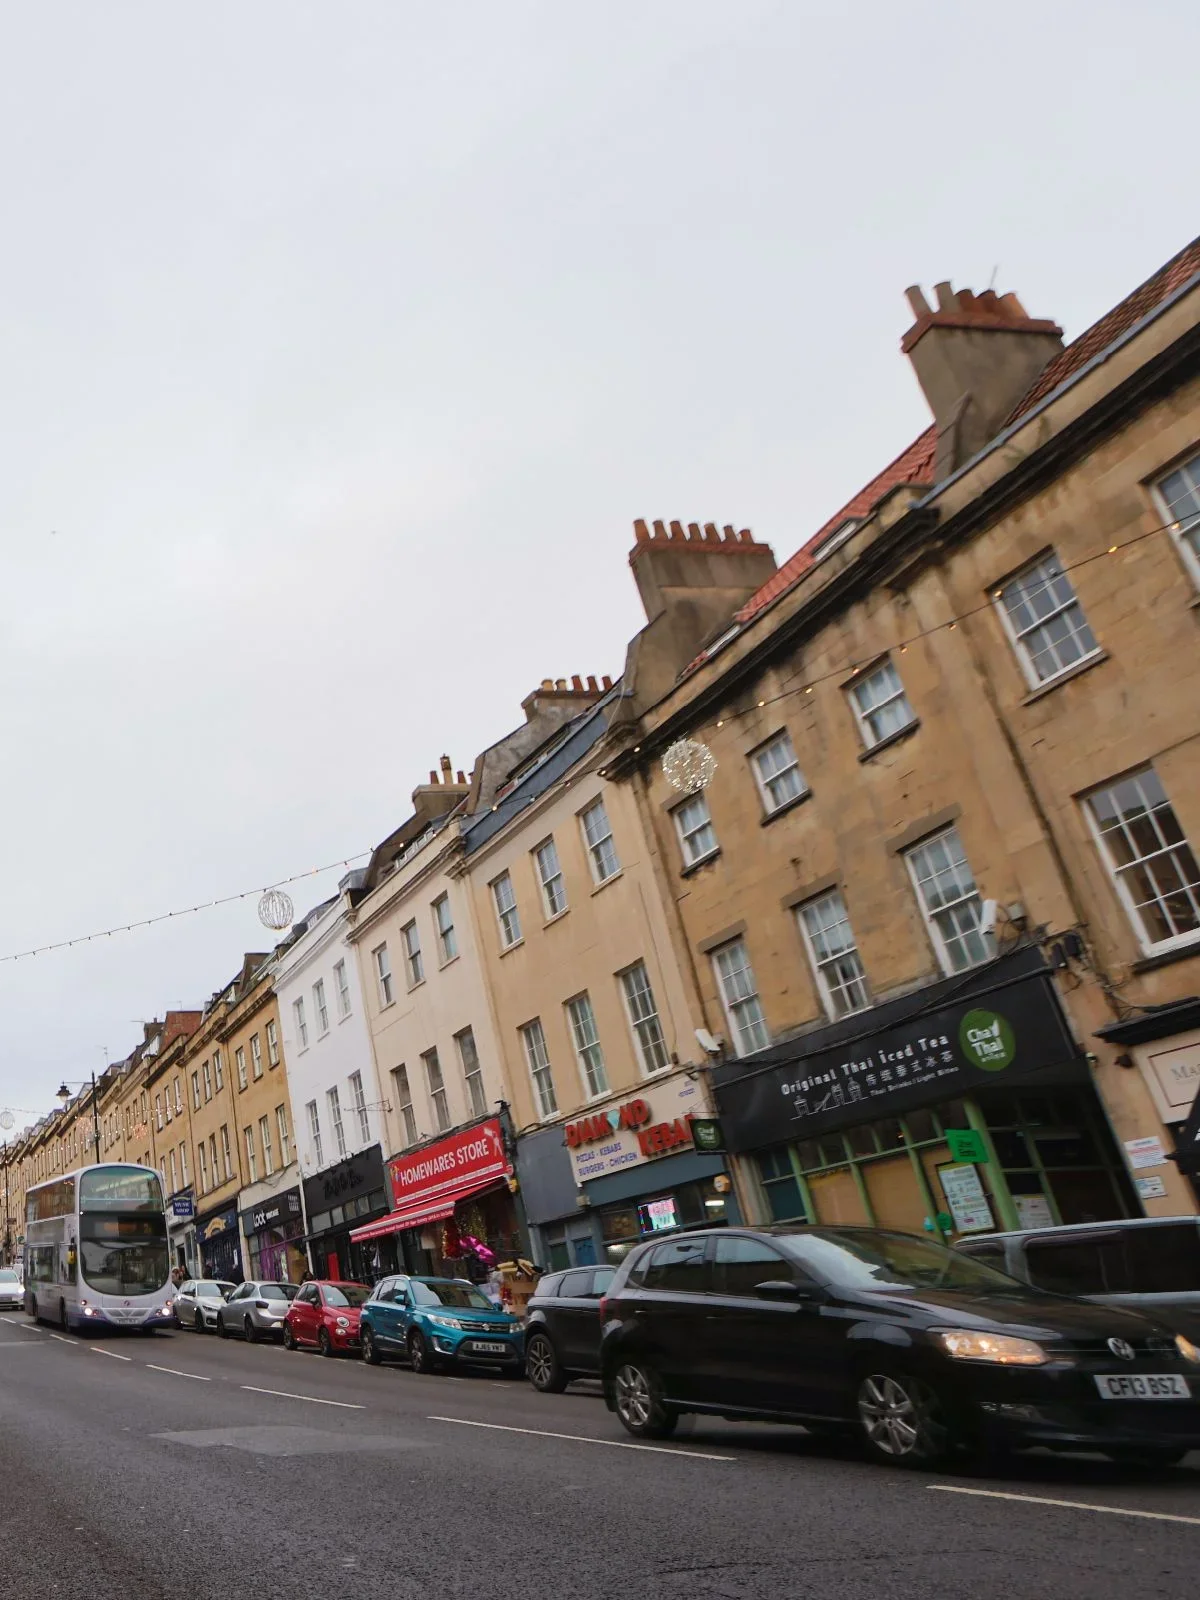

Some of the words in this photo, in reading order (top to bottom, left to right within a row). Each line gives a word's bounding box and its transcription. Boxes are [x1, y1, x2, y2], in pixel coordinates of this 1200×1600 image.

[781, 1068, 838, 1095] Original
[841, 1057, 874, 1076] Thai
[918, 1035, 949, 1051] Tea
[638, 1113, 696, 1156] KEBA
[400, 1151, 456, 1187] HOMEWARES
[457, 1138, 490, 1165] STORE
[610, 1152, 637, 1167] CHICKEN
[1107, 1377, 1146, 1395] CF13
[1146, 1377, 1181, 1395] BSZ
